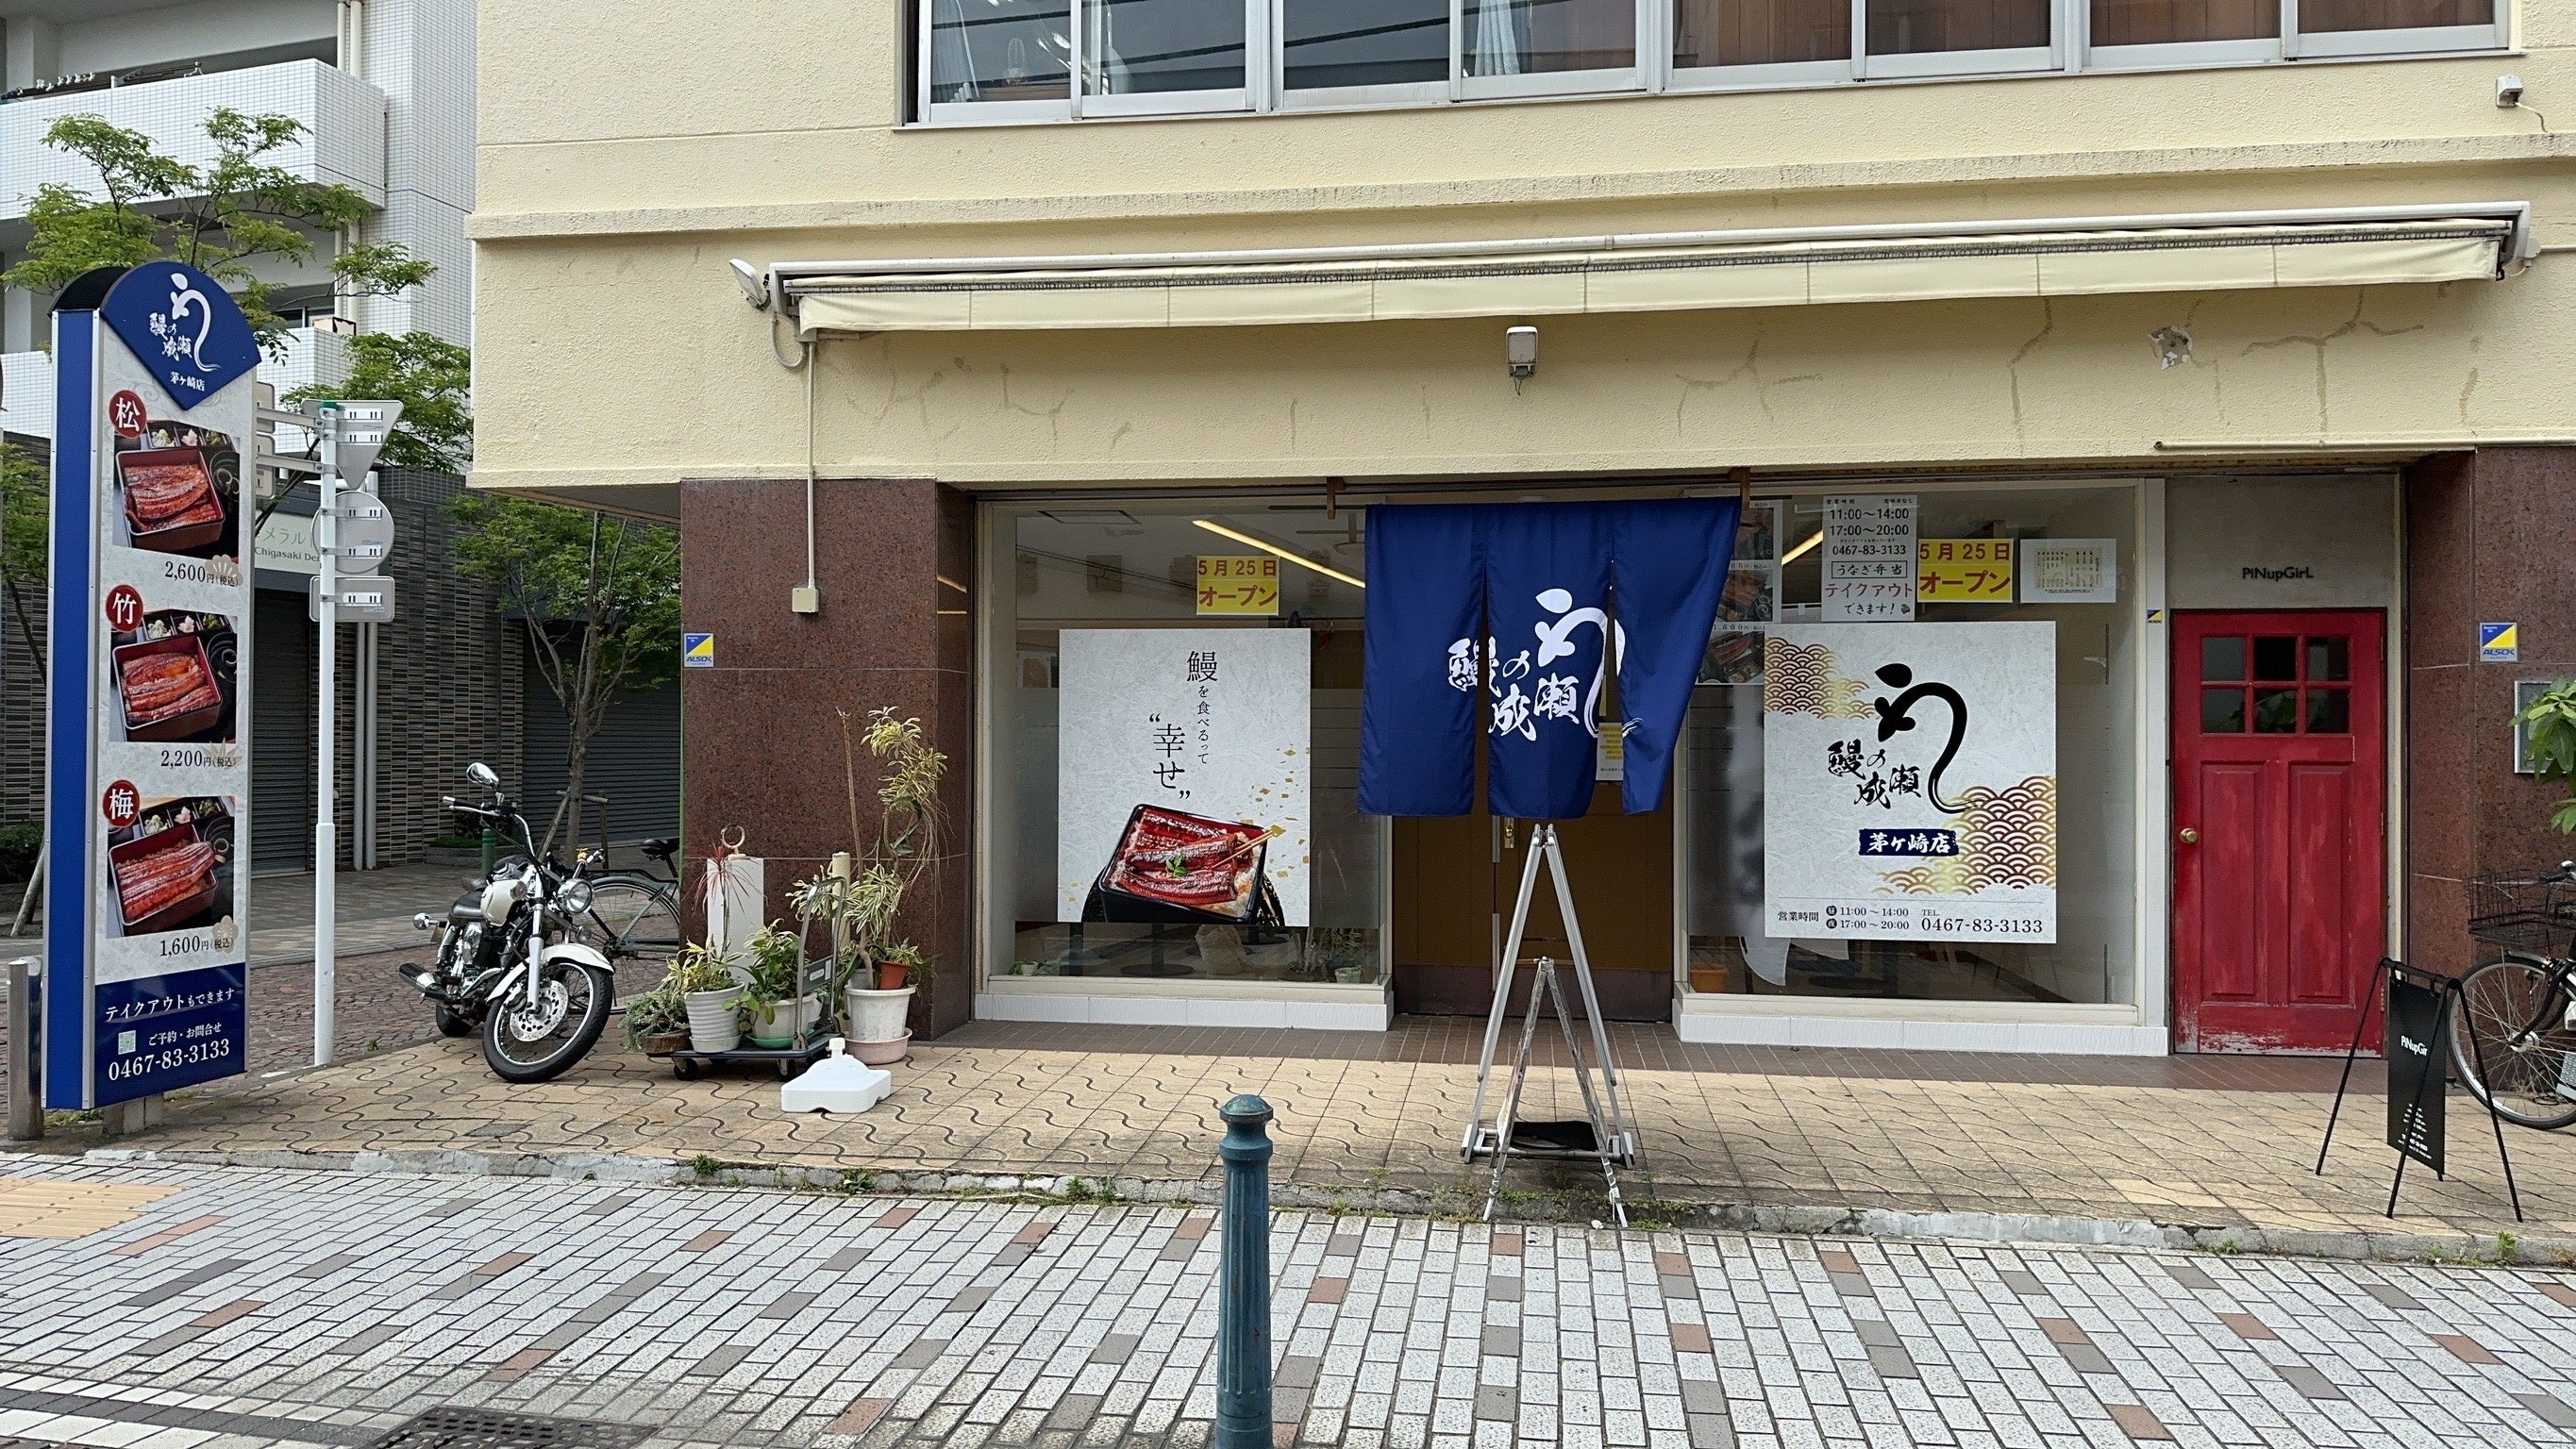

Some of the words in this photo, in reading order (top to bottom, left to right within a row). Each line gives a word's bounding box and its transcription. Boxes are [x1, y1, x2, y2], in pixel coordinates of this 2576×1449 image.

[115, 397, 141, 432] 松
[255, 546, 302, 559] Chigasaki
[1832, 544, 1907, 555] 0467-83-3133
[1836, 563, 1902, 576] うなぎ弁当
[1825, 582, 1914, 598] テイクアウト
[1919, 569, 2011, 593] オープン
[1198, 585, 1278, 607] オープン
[112, 592, 137, 625] 竹
[1845, 602, 1895, 616] できます!
[1186, 650, 1218, 765] 鰻を食べるって
[109, 788, 134, 821] 梅
[1777, 910, 1820, 923] 営業時間
[1921, 917, 2043, 934] 0467-83-3133
[105, 987, 235, 1023] テイクアウトもできます
[2400, 1035, 2429, 1057] PiNupGir
[109, 1039, 230, 1081] 0467-83-3133
